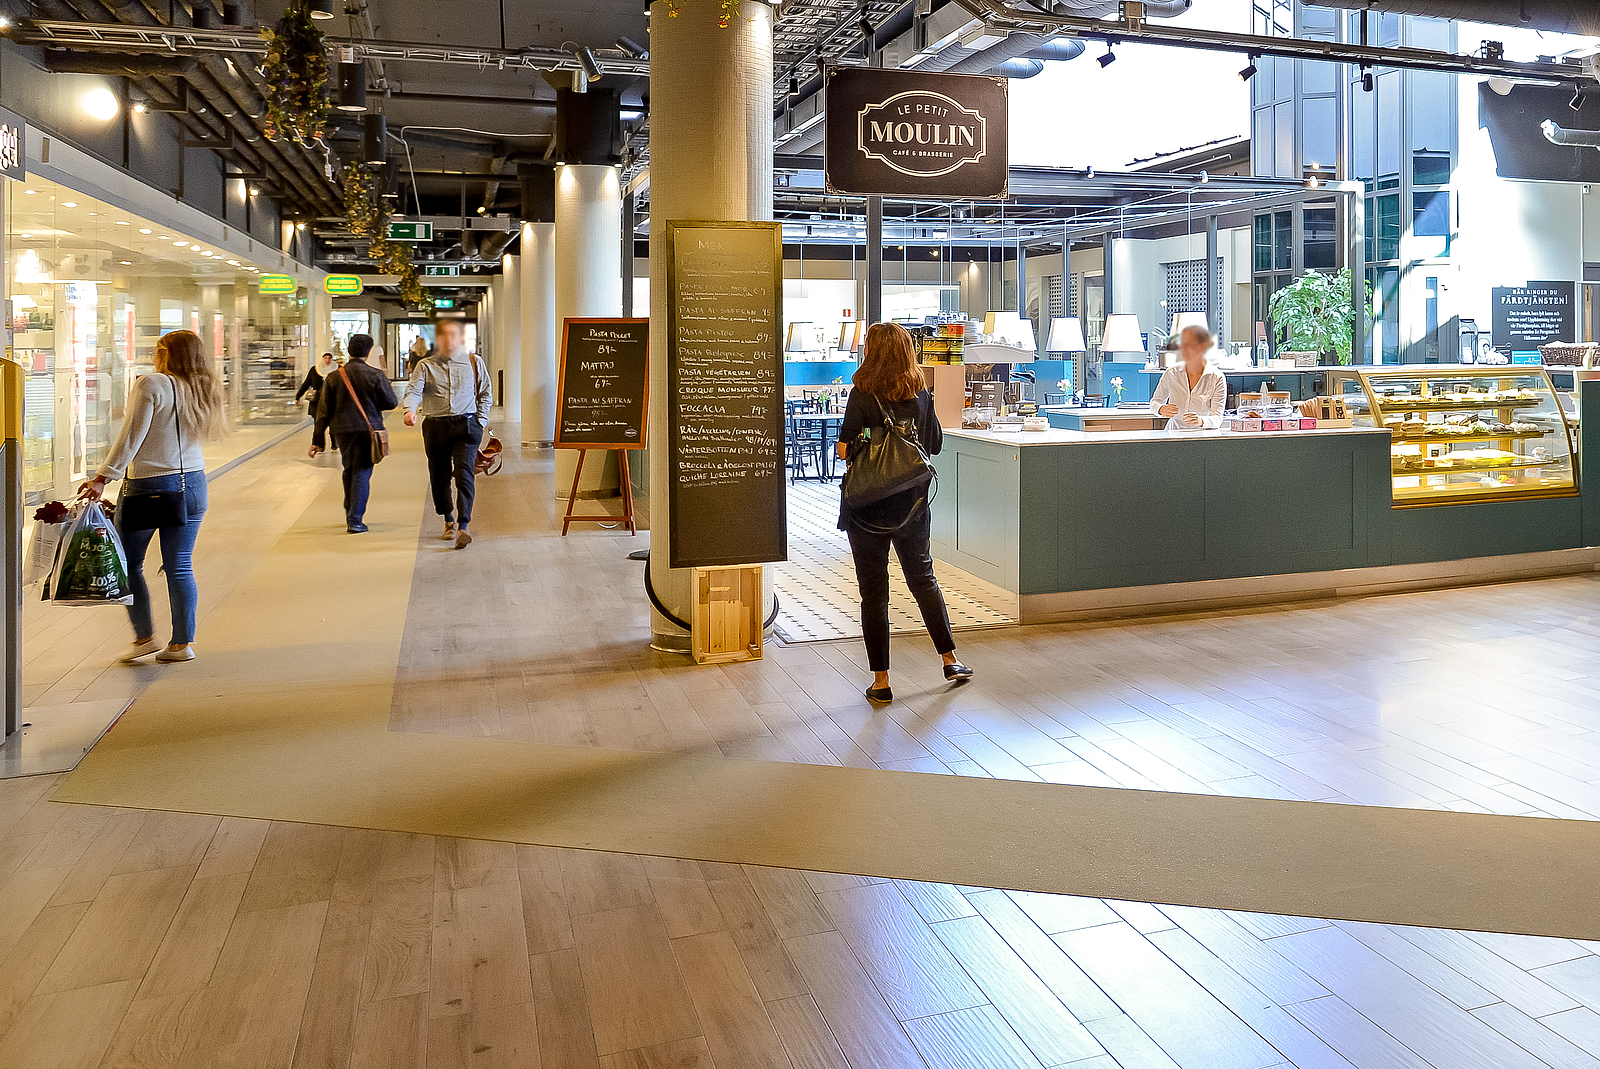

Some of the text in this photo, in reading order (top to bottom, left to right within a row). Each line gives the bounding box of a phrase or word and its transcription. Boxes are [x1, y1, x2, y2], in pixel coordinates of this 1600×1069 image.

[898, 104, 949, 118] LE PETIT
[870, 121, 975, 147] MOULIN
[918, 150, 954, 158] BRASSERIE
[1501, 294, 1568, 305] FÄRDTJÄNSTEN!
[679, 305, 704, 315] PASTA
[589, 328, 608, 338] PASTA
[679, 326, 703, 336] PASTA
[678, 347, 702, 356] PASTA
[580, 361, 615, 371] MATPAJ
[678, 367, 702, 376] PASTA
[678, 386, 715, 395] CROQUE
[717, 386, 760, 394] MONSIEUR
[568, 396, 588, 405] PASTA
[601, 396, 632, 405] SAFFRAN
[679, 403, 726, 414] FOCCACIA
[679, 461, 716, 470] BROCCOLI
[679, 472, 708, 483] QUICHE
